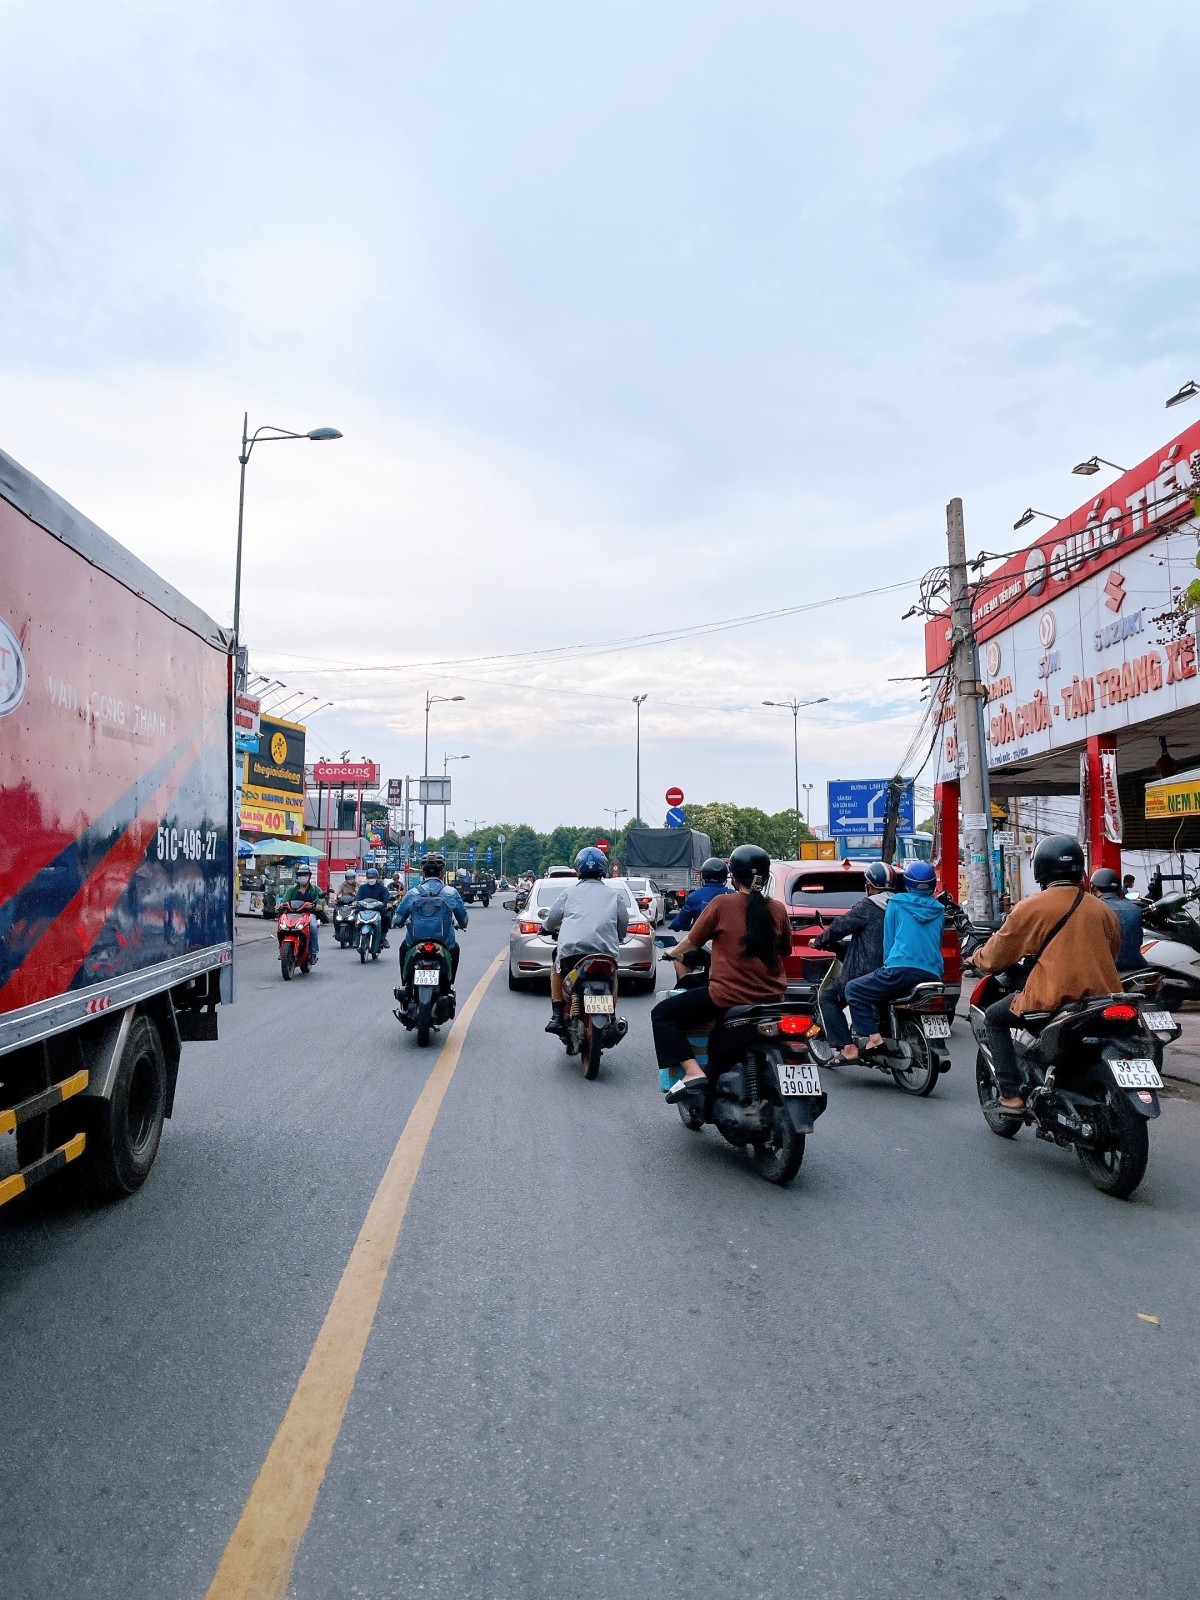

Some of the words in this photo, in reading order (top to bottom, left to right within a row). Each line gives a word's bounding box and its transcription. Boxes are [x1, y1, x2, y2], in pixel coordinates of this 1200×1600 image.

[1050, 498, 1122, 582] QUỐC
[1094, 609, 1145, 651] SUZUKI
[1097, 650, 1163, 708] TRANG
[1167, 792, 1192, 812] NEM
[785, 1066, 813, 1079] 47-C1
[1118, 1073, 1160, 1086] 045.40
[782, 1080, 820, 1094] 390.04
